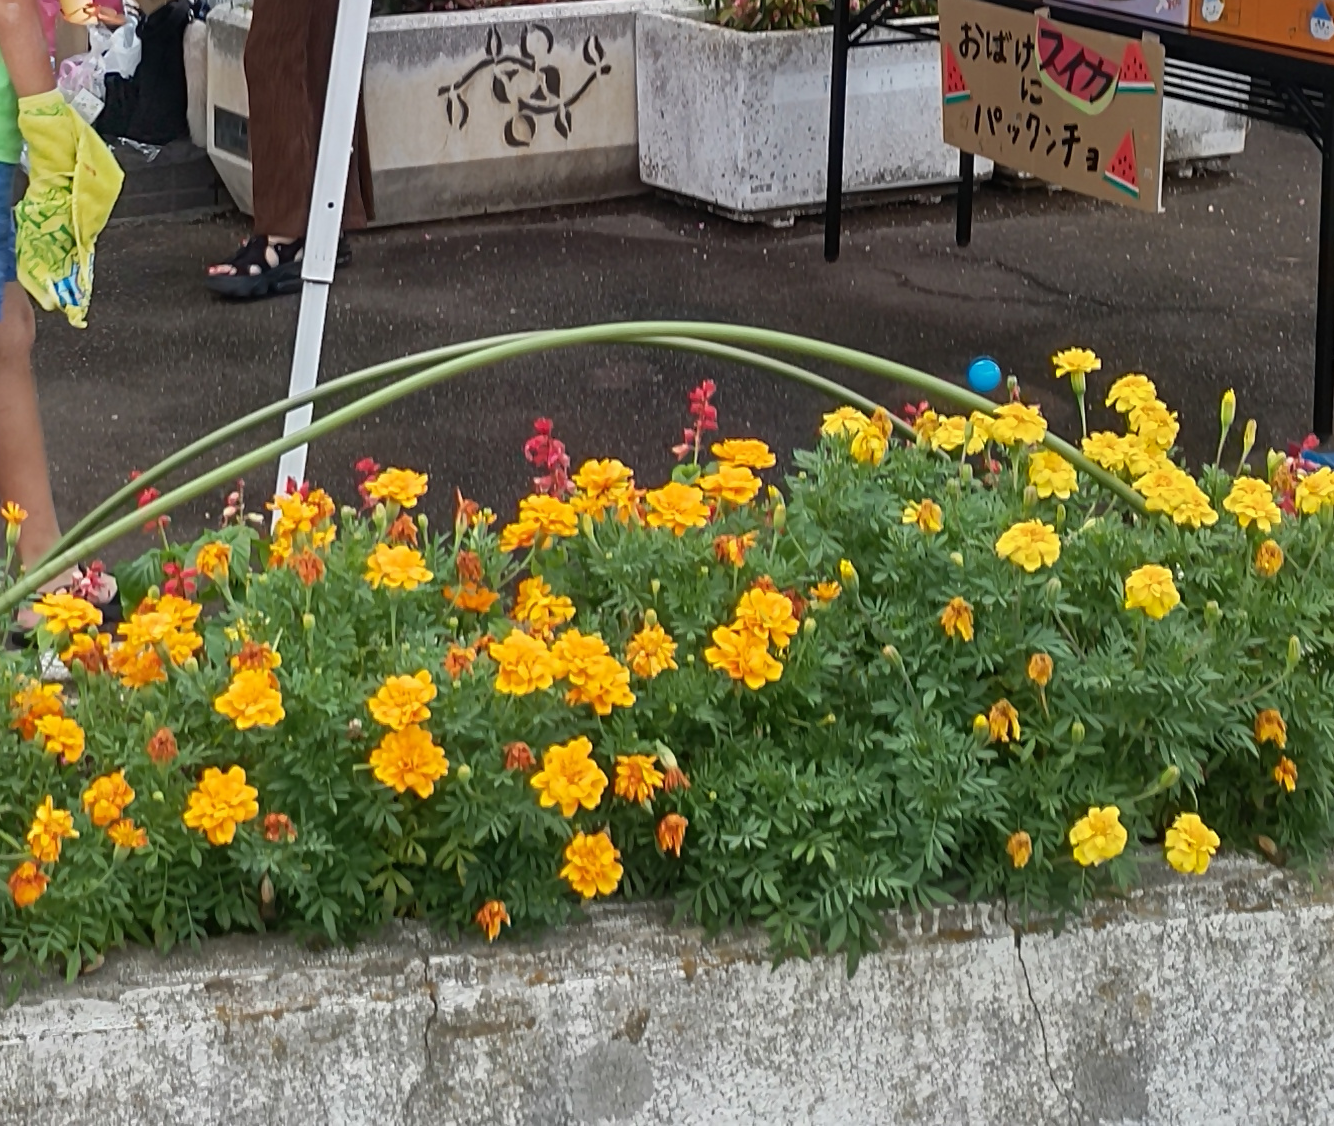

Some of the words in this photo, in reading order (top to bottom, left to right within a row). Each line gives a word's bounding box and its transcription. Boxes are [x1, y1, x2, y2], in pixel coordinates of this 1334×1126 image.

[1021, 76, 1043, 105] に
[973, 104, 1100, 173] パックンチョ
